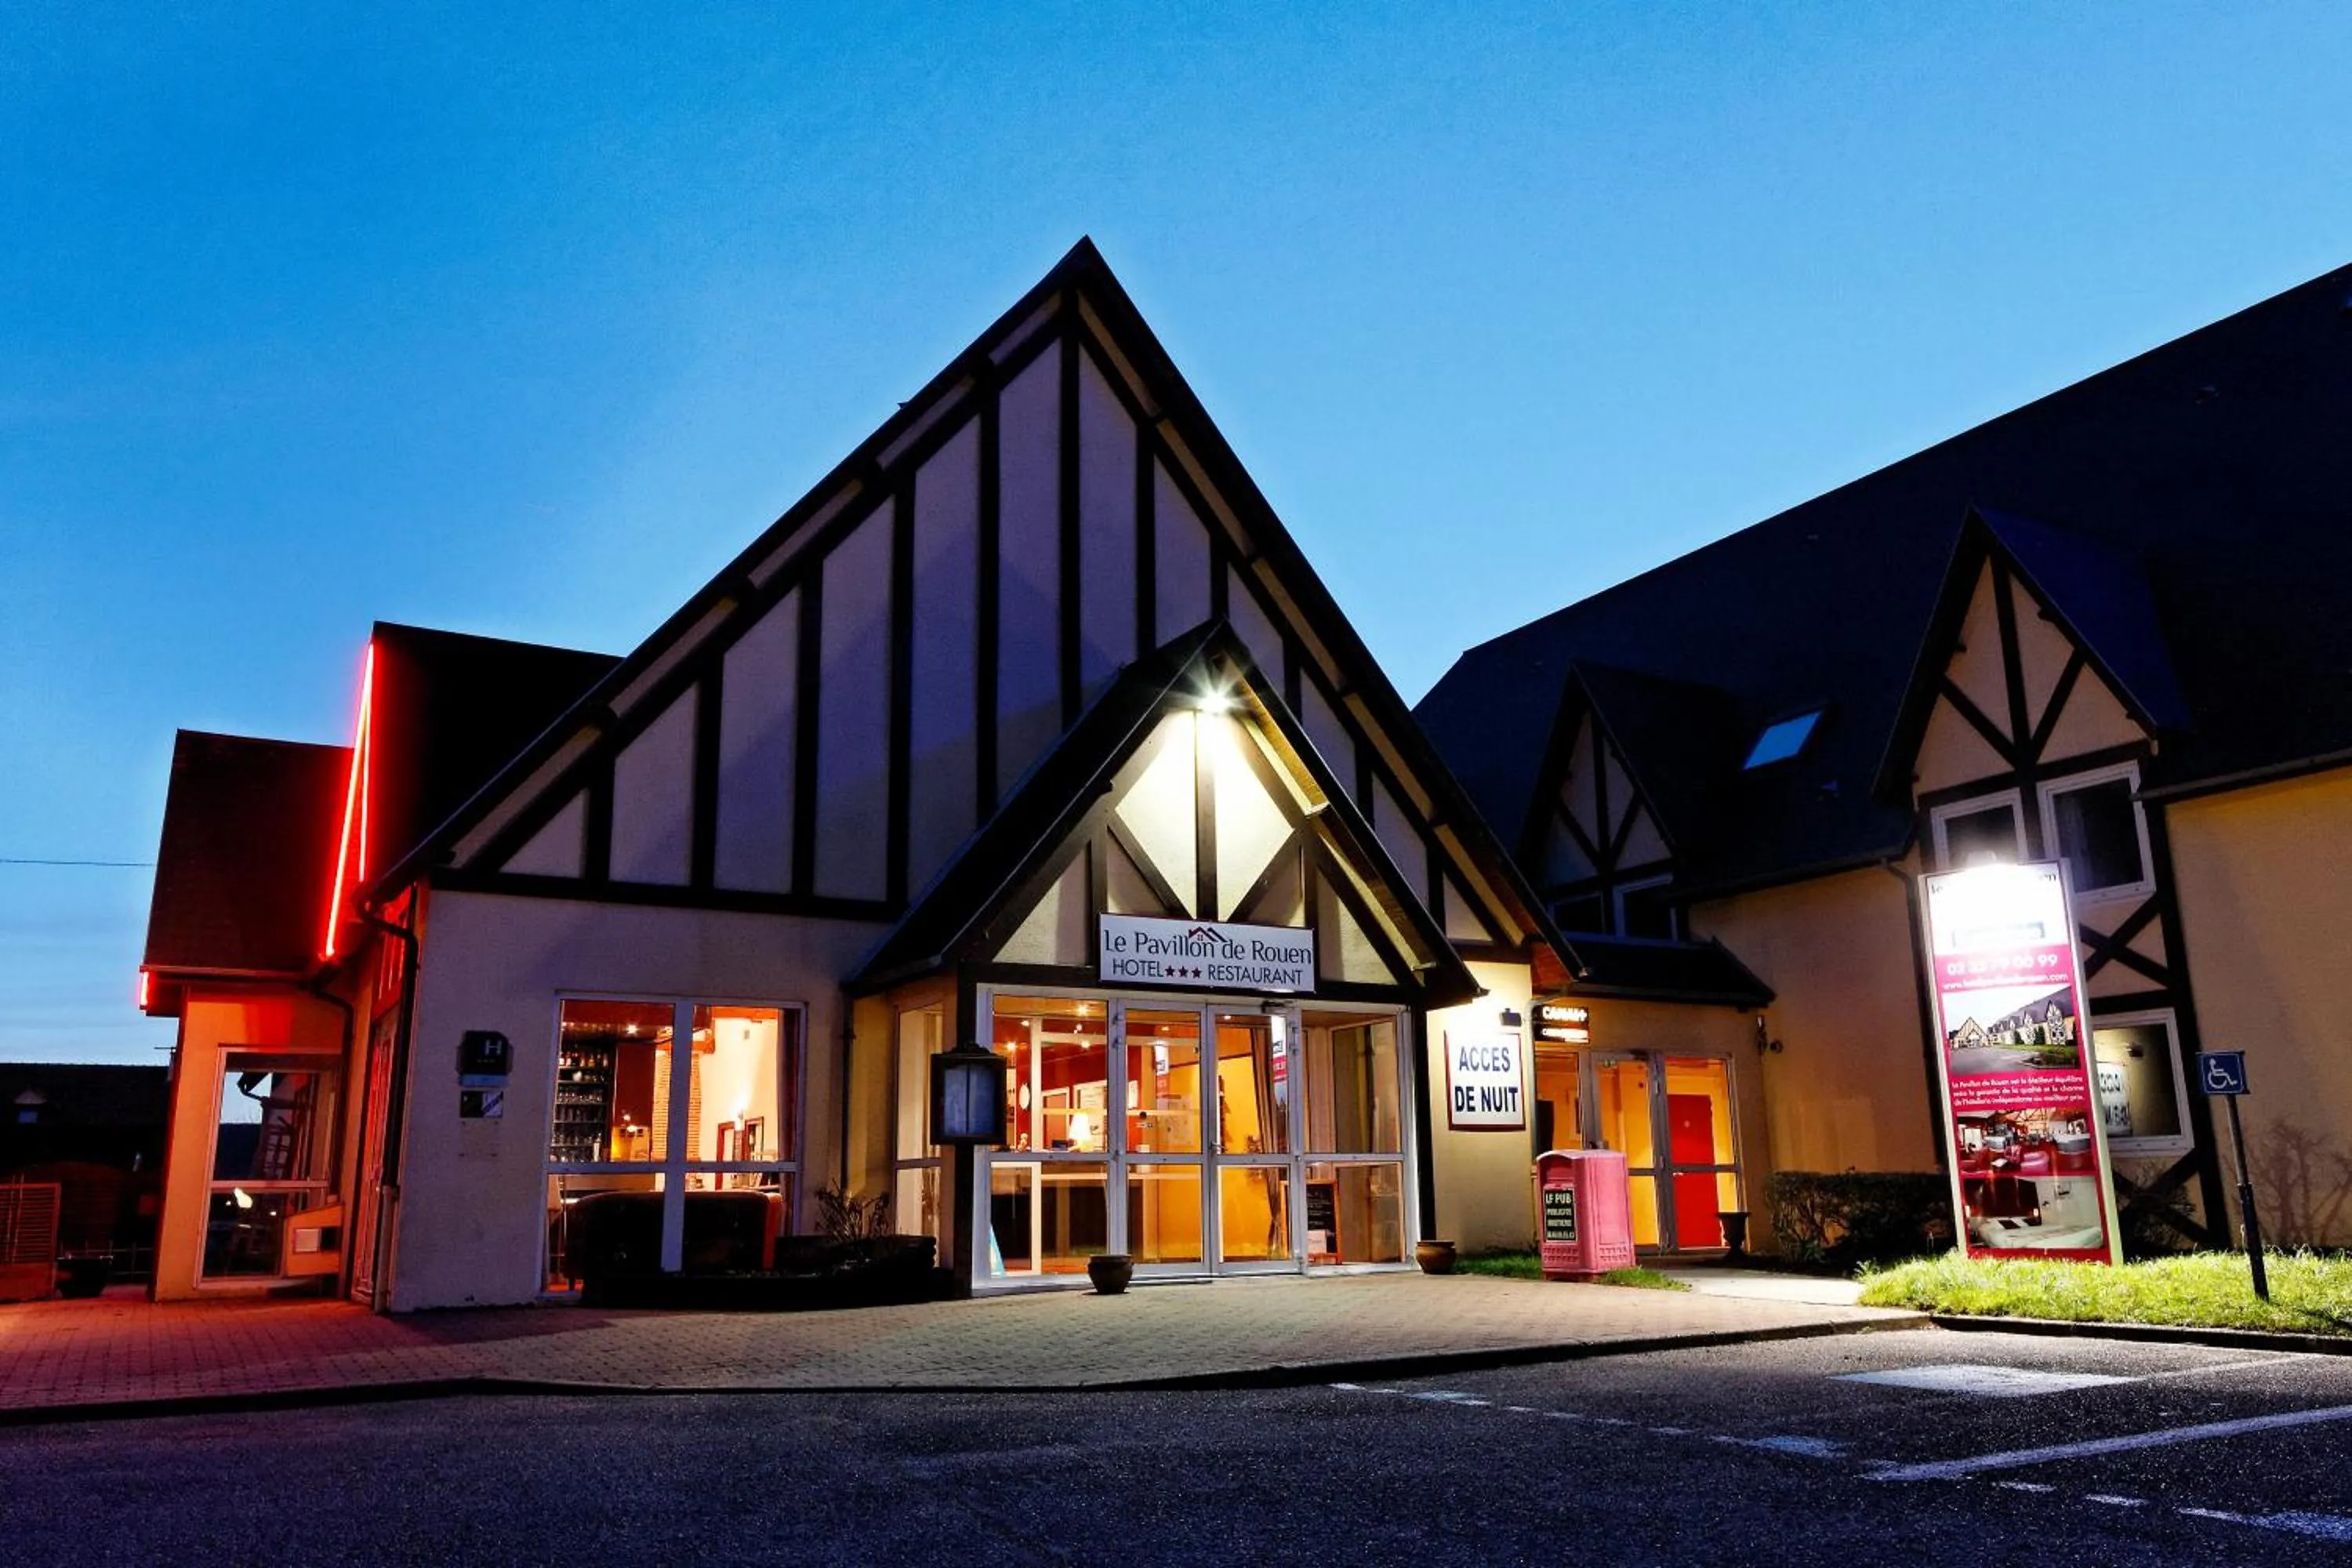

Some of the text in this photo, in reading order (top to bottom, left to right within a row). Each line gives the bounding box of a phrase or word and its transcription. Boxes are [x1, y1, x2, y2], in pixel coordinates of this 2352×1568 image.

[1104, 929, 1312, 964] Le Pavillon de Rouen
[1112, 959, 1303, 985] HOTEL RESTAURANT
[2038, 953, 2058, 967] 99
[1459, 1047, 1512, 1073] ACCES
[1454, 1086, 1518, 1112] DE NUIT
[1555, 1192, 1571, 1203] PUB
